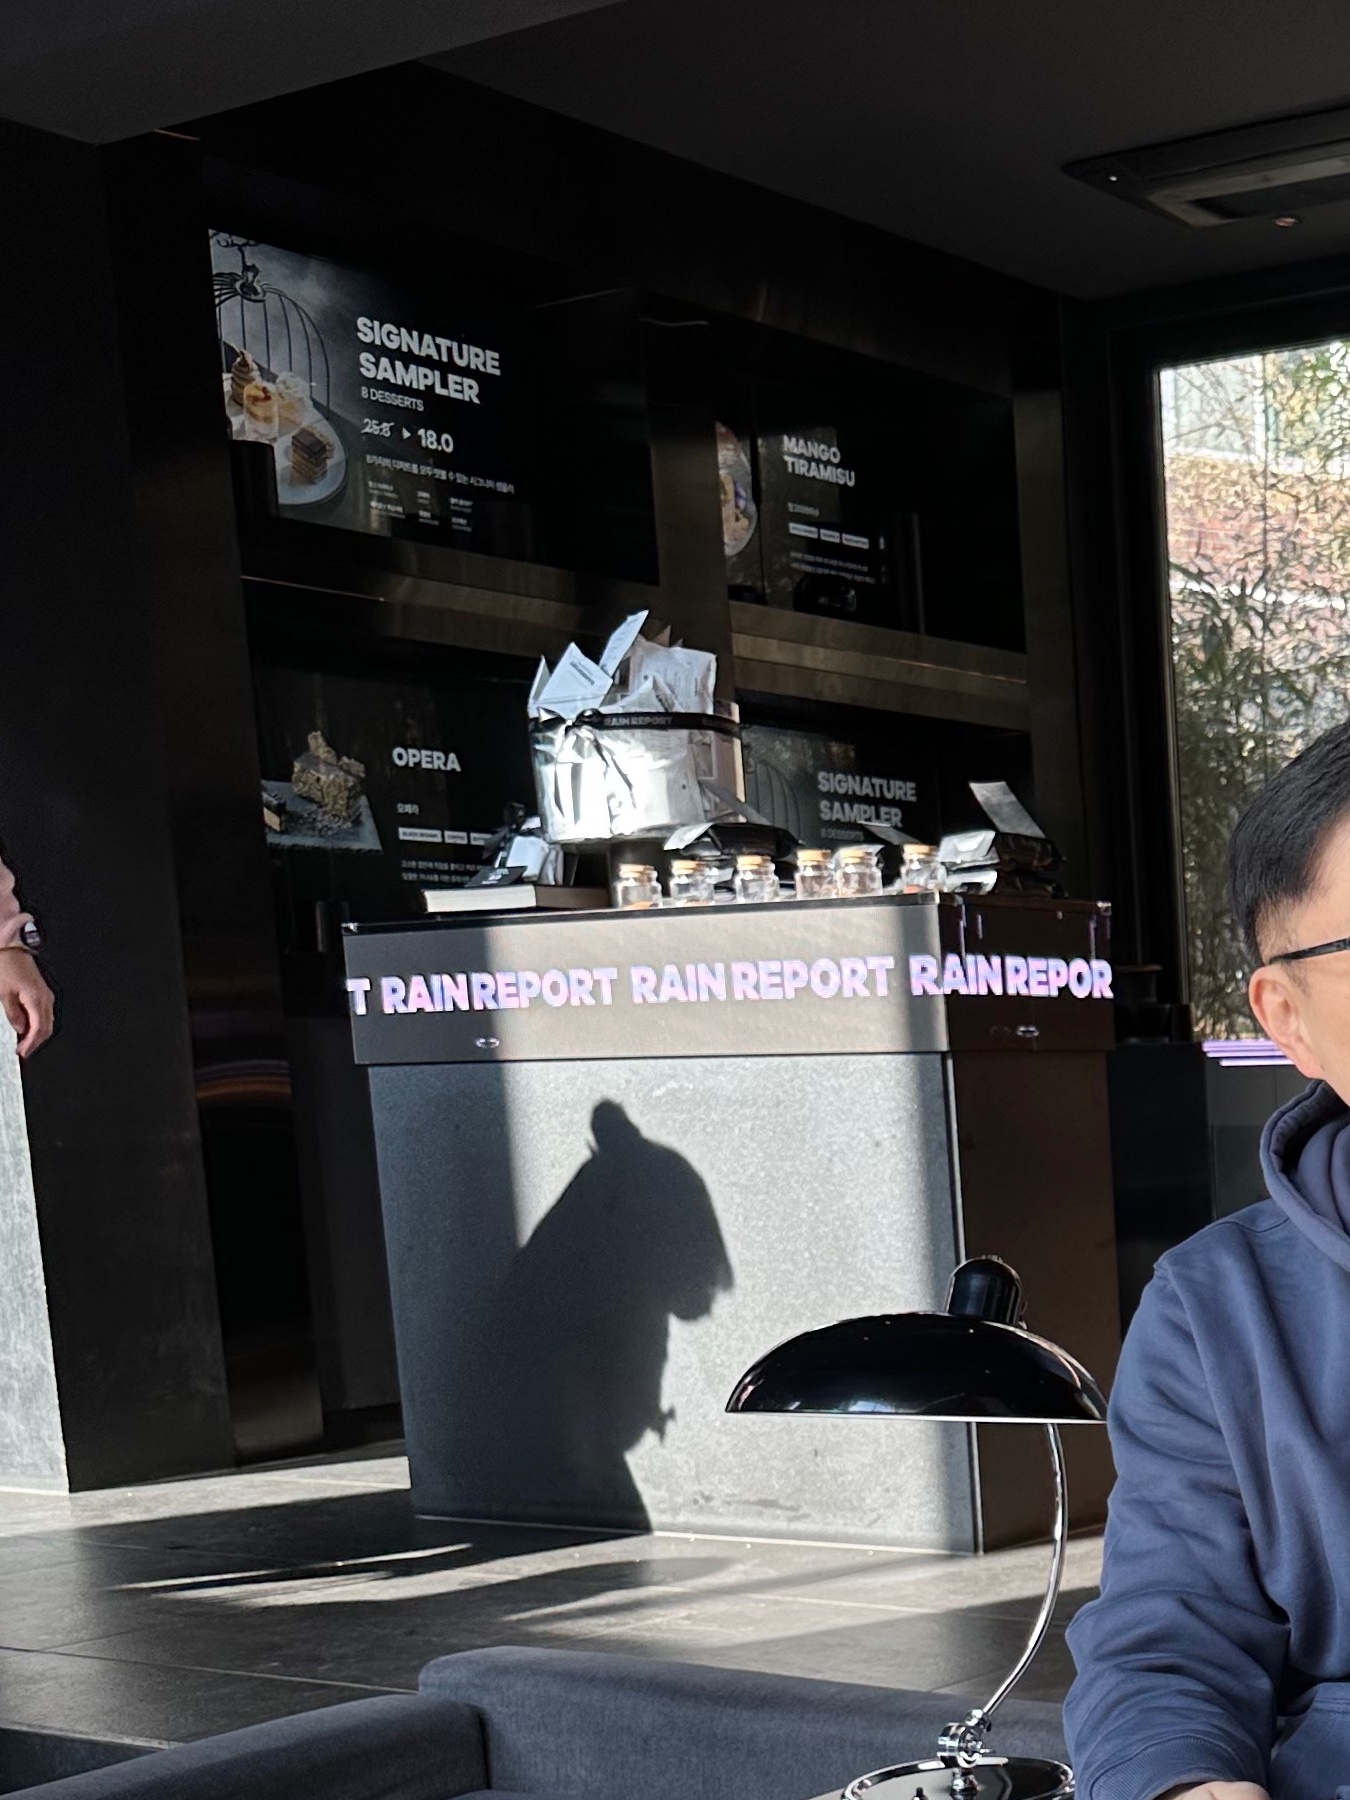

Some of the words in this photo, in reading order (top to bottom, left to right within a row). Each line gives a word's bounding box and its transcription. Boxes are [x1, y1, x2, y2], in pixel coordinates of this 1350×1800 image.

[356, 316, 501, 376] SIGNATURE
[359, 352, 480, 404] SAMPLER
[361, 386, 369, 399] 8
[370, 388, 424, 411] DESSERTS
[417, 428, 454, 453] 18.0
[783, 434, 841, 464] MANGO
[784, 455, 855, 487] TIRAMISU
[392, 747, 461, 772] OPERA
[818, 771, 917, 802] SIGNATURE
[820, 800, 903, 828] SAMPLER
